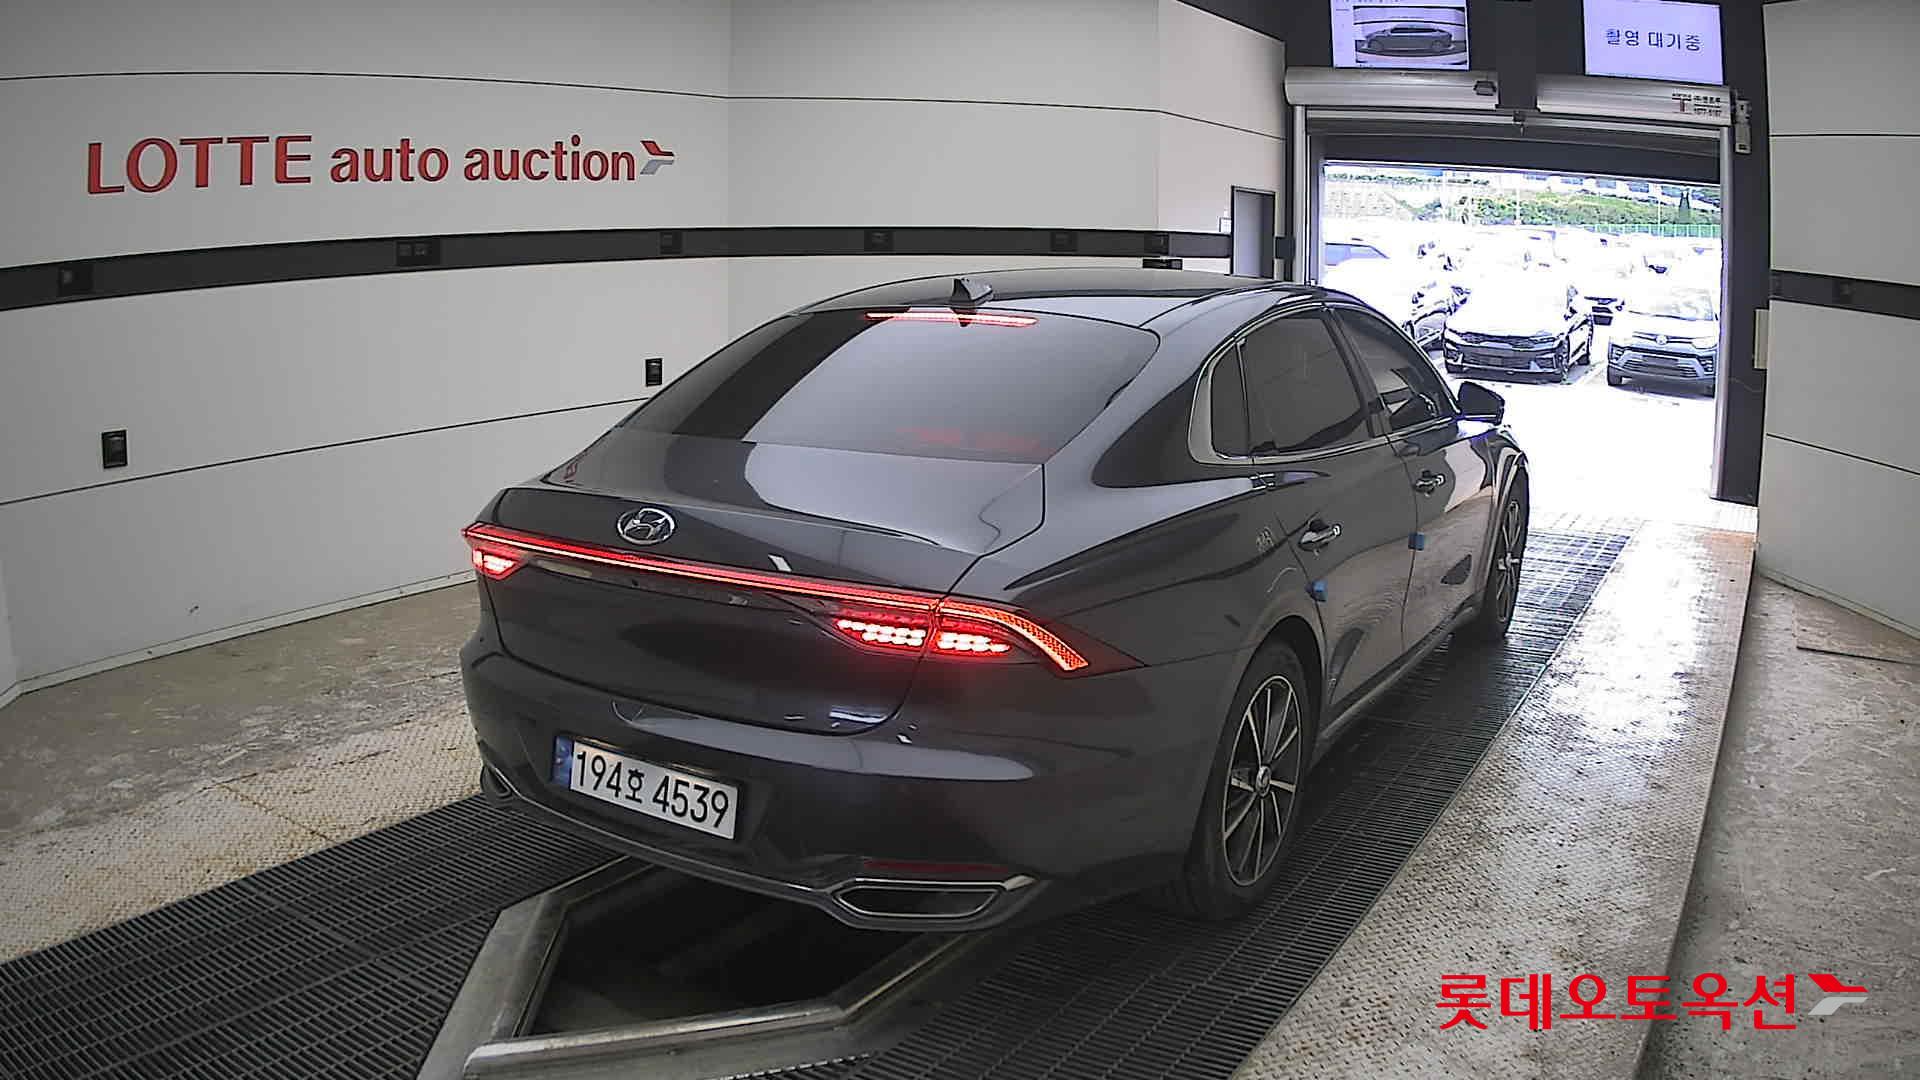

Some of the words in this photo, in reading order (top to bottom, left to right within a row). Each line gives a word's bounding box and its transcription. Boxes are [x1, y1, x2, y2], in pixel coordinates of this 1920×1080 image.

[86, 135, 312, 194] LOTTE
[330, 137, 449, 183] auto
[463, 134, 636, 181] auction
[577, 751, 645, 804] 194호
[652, 775, 729, 828] 4539
